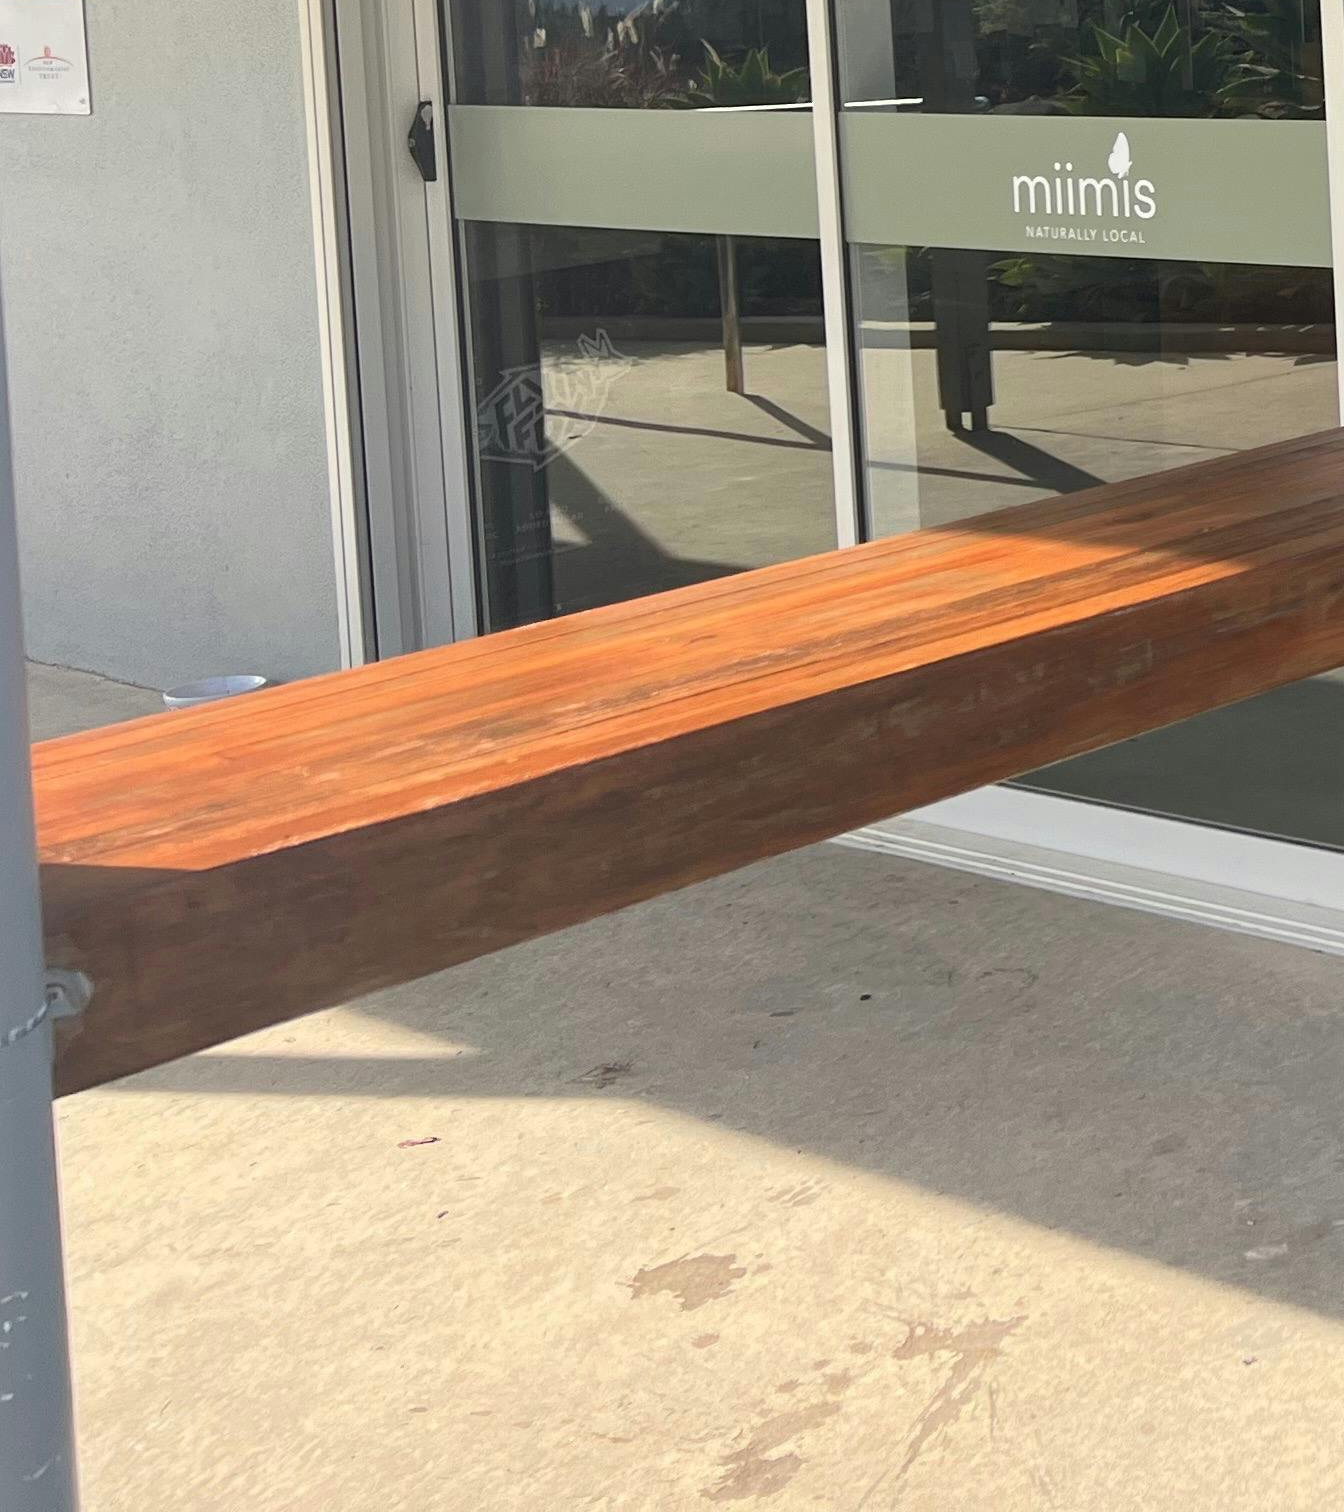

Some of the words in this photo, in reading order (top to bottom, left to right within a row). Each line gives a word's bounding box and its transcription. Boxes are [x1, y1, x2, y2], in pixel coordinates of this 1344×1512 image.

[1012, 162, 1157, 219] miimis
[1025, 225, 1097, 242] NATURALLY
[1102, 229, 1146, 245] LOCAL
